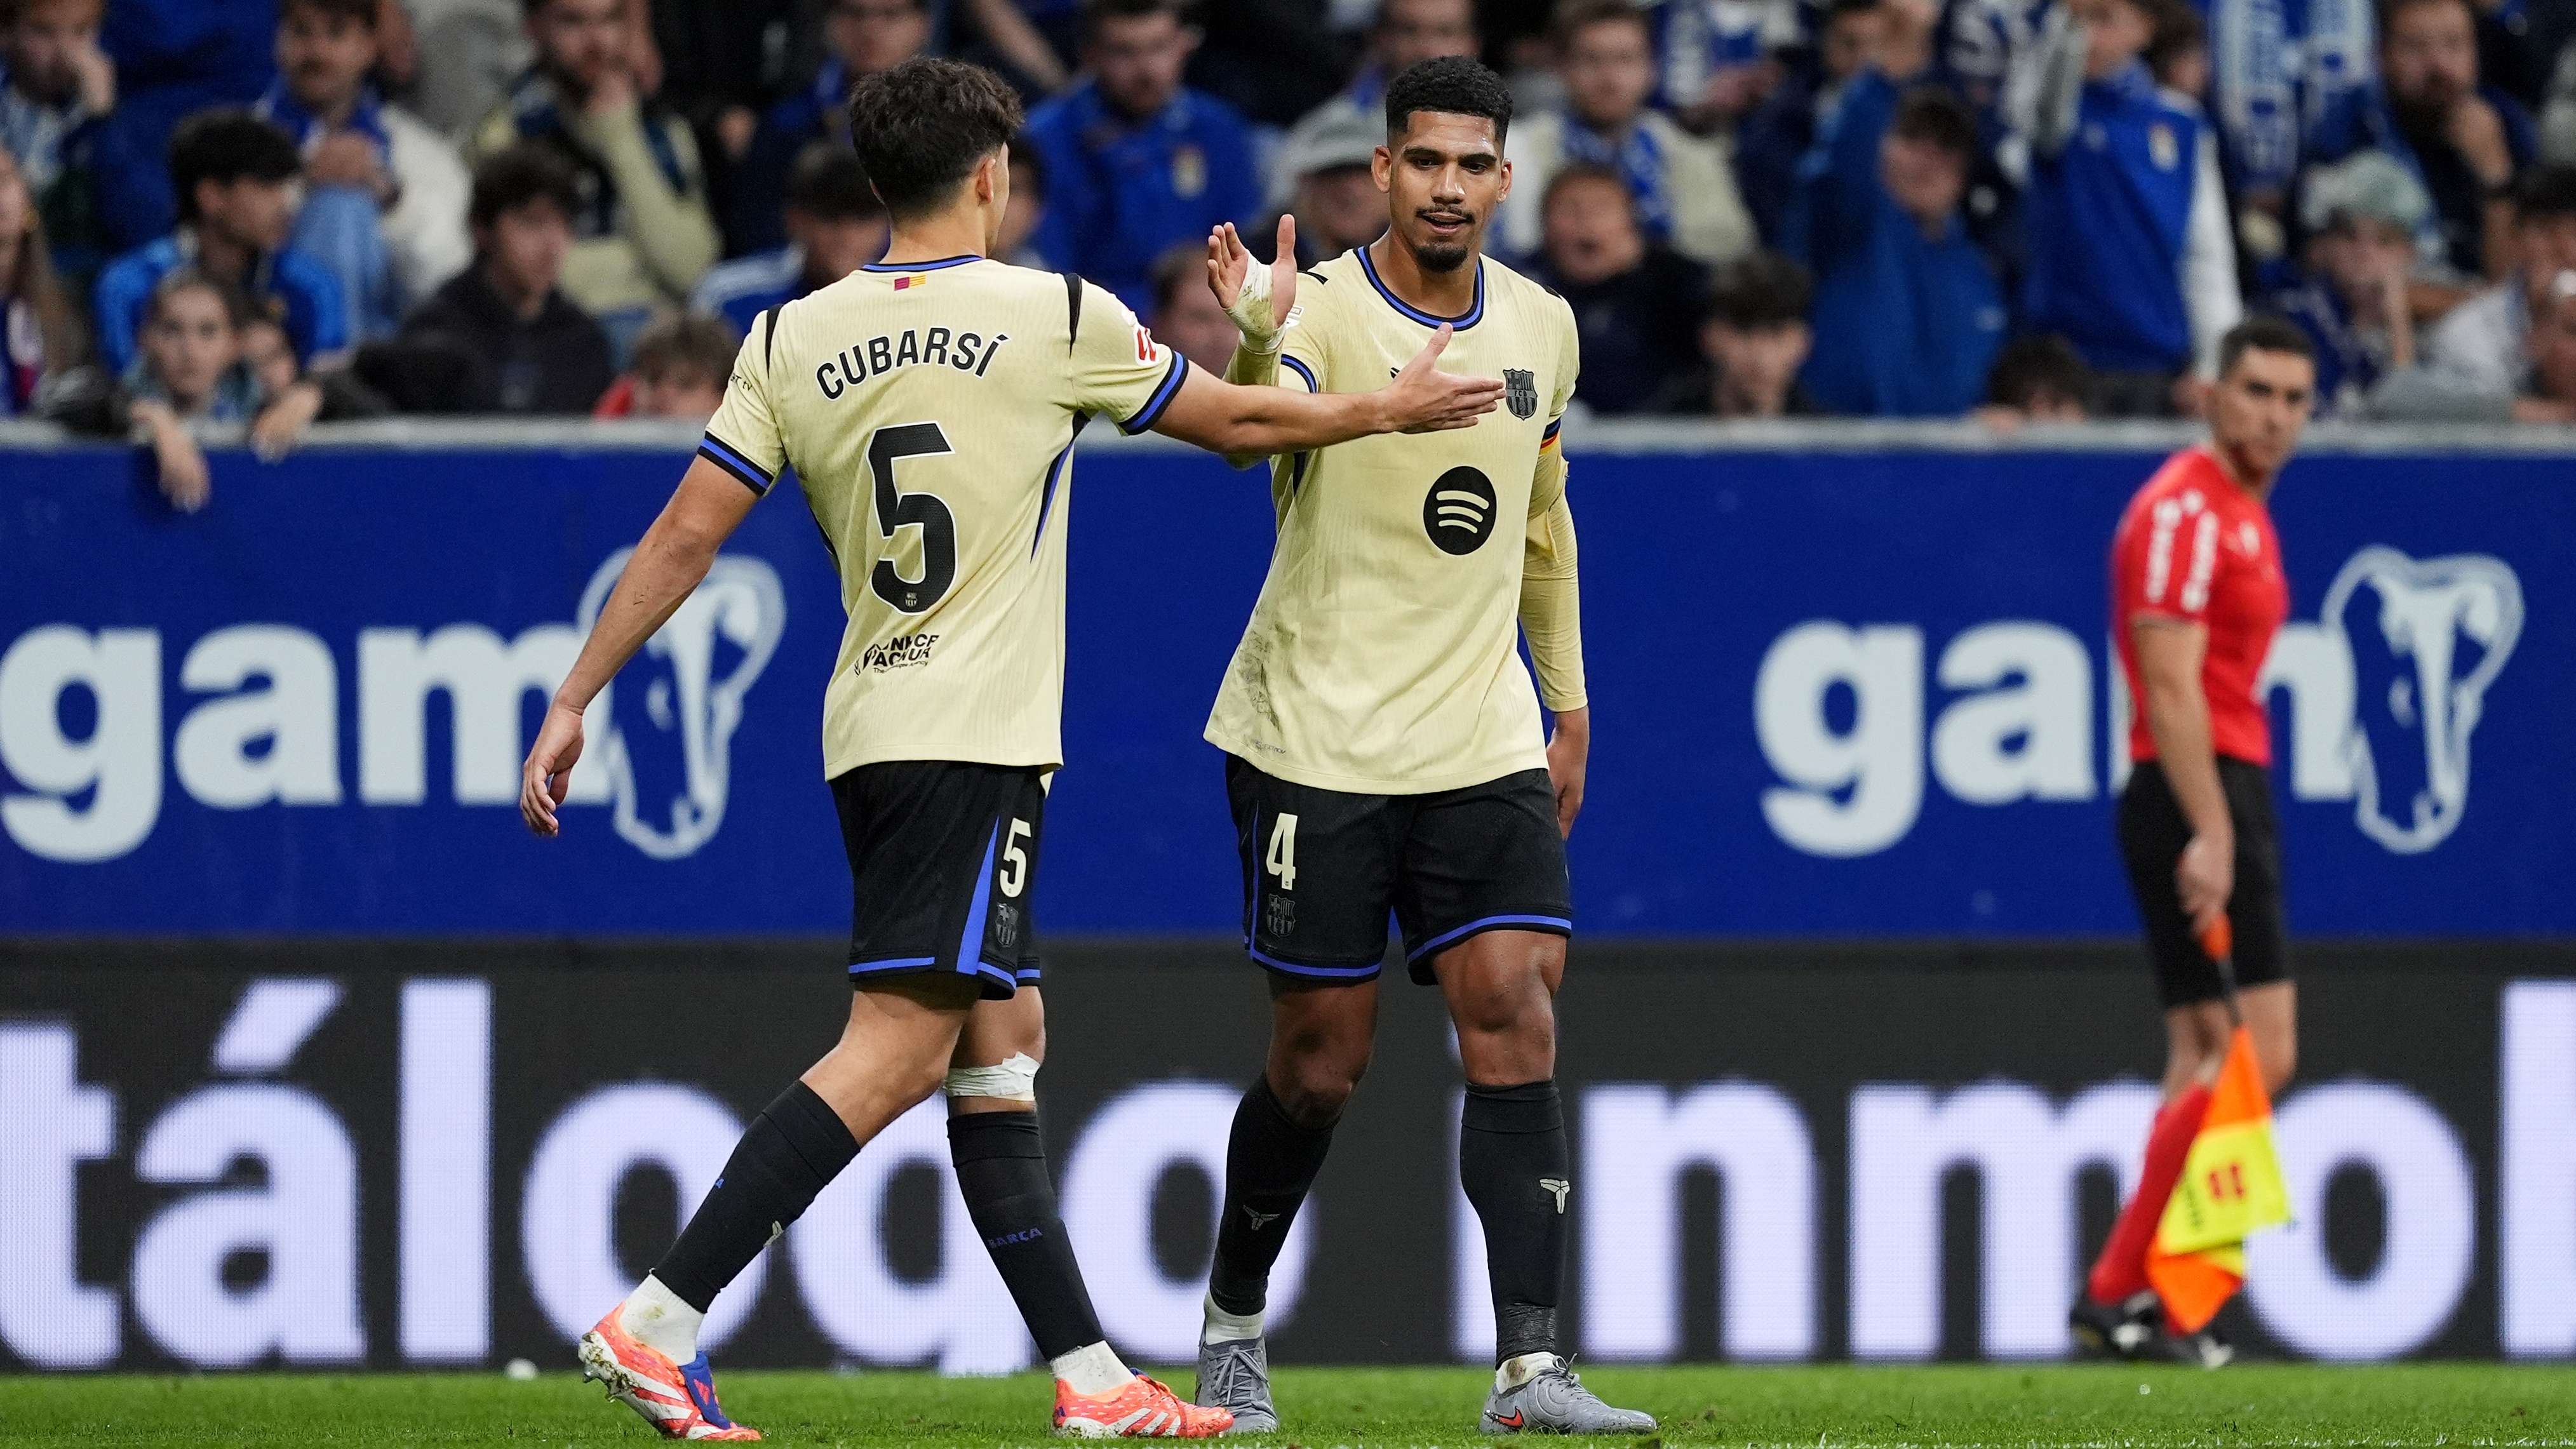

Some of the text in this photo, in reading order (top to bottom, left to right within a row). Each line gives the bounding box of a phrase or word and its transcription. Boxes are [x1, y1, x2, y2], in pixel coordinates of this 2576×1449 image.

[815, 326, 1010, 402] CUBARSÍ
[866, 421, 958, 616] 5
[1000, 817, 1031, 898] 5
[1266, 812, 1298, 890] 4
